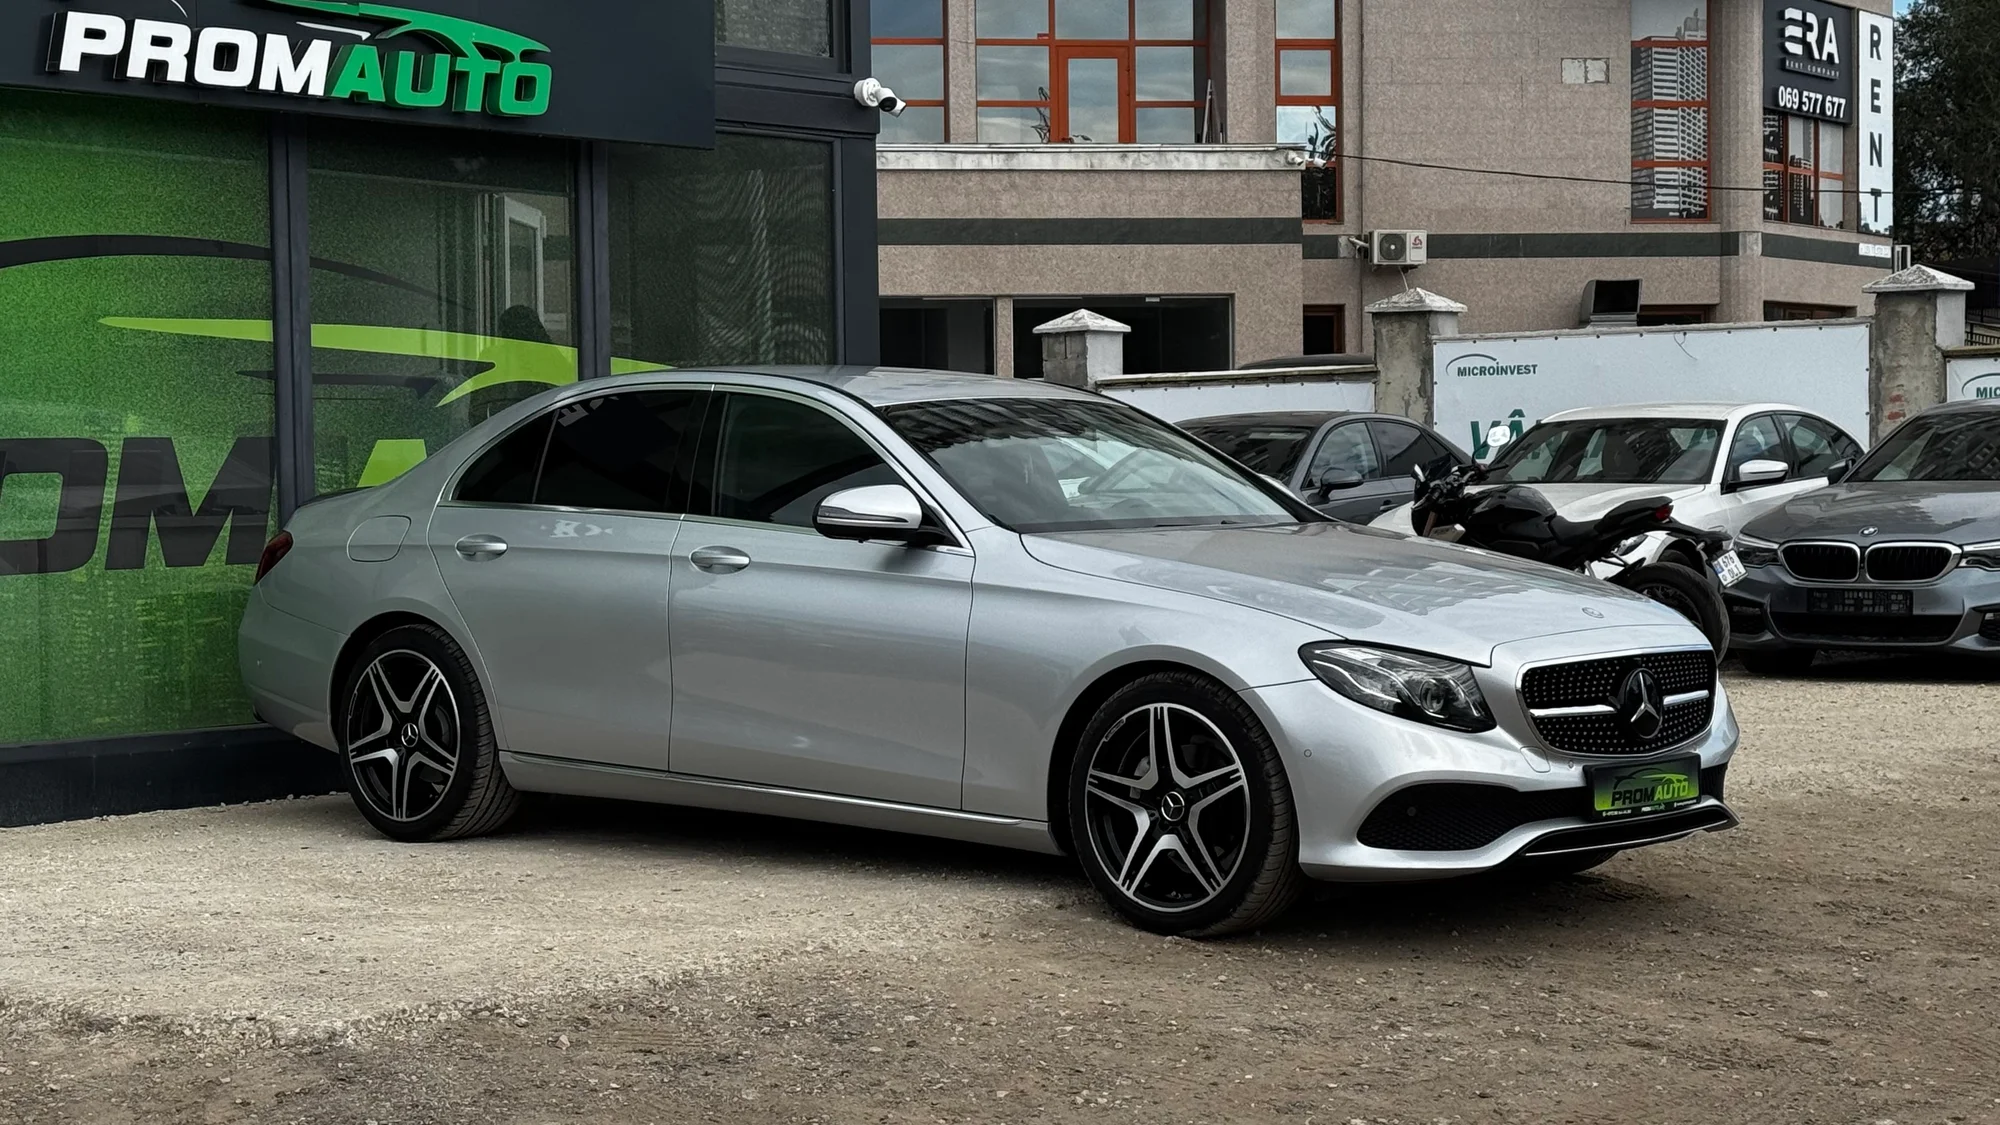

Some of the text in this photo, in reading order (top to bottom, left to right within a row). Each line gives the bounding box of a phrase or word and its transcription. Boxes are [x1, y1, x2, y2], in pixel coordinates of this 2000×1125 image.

[58, 10, 553, 116] PROMAUTO
[1784, 7, 1839, 64] ERA
[1778, 85, 1846, 119] 069 577 677
[1869, 23, 1883, 223] RENT
[1611, 780, 1689, 807] PROMAUTO
